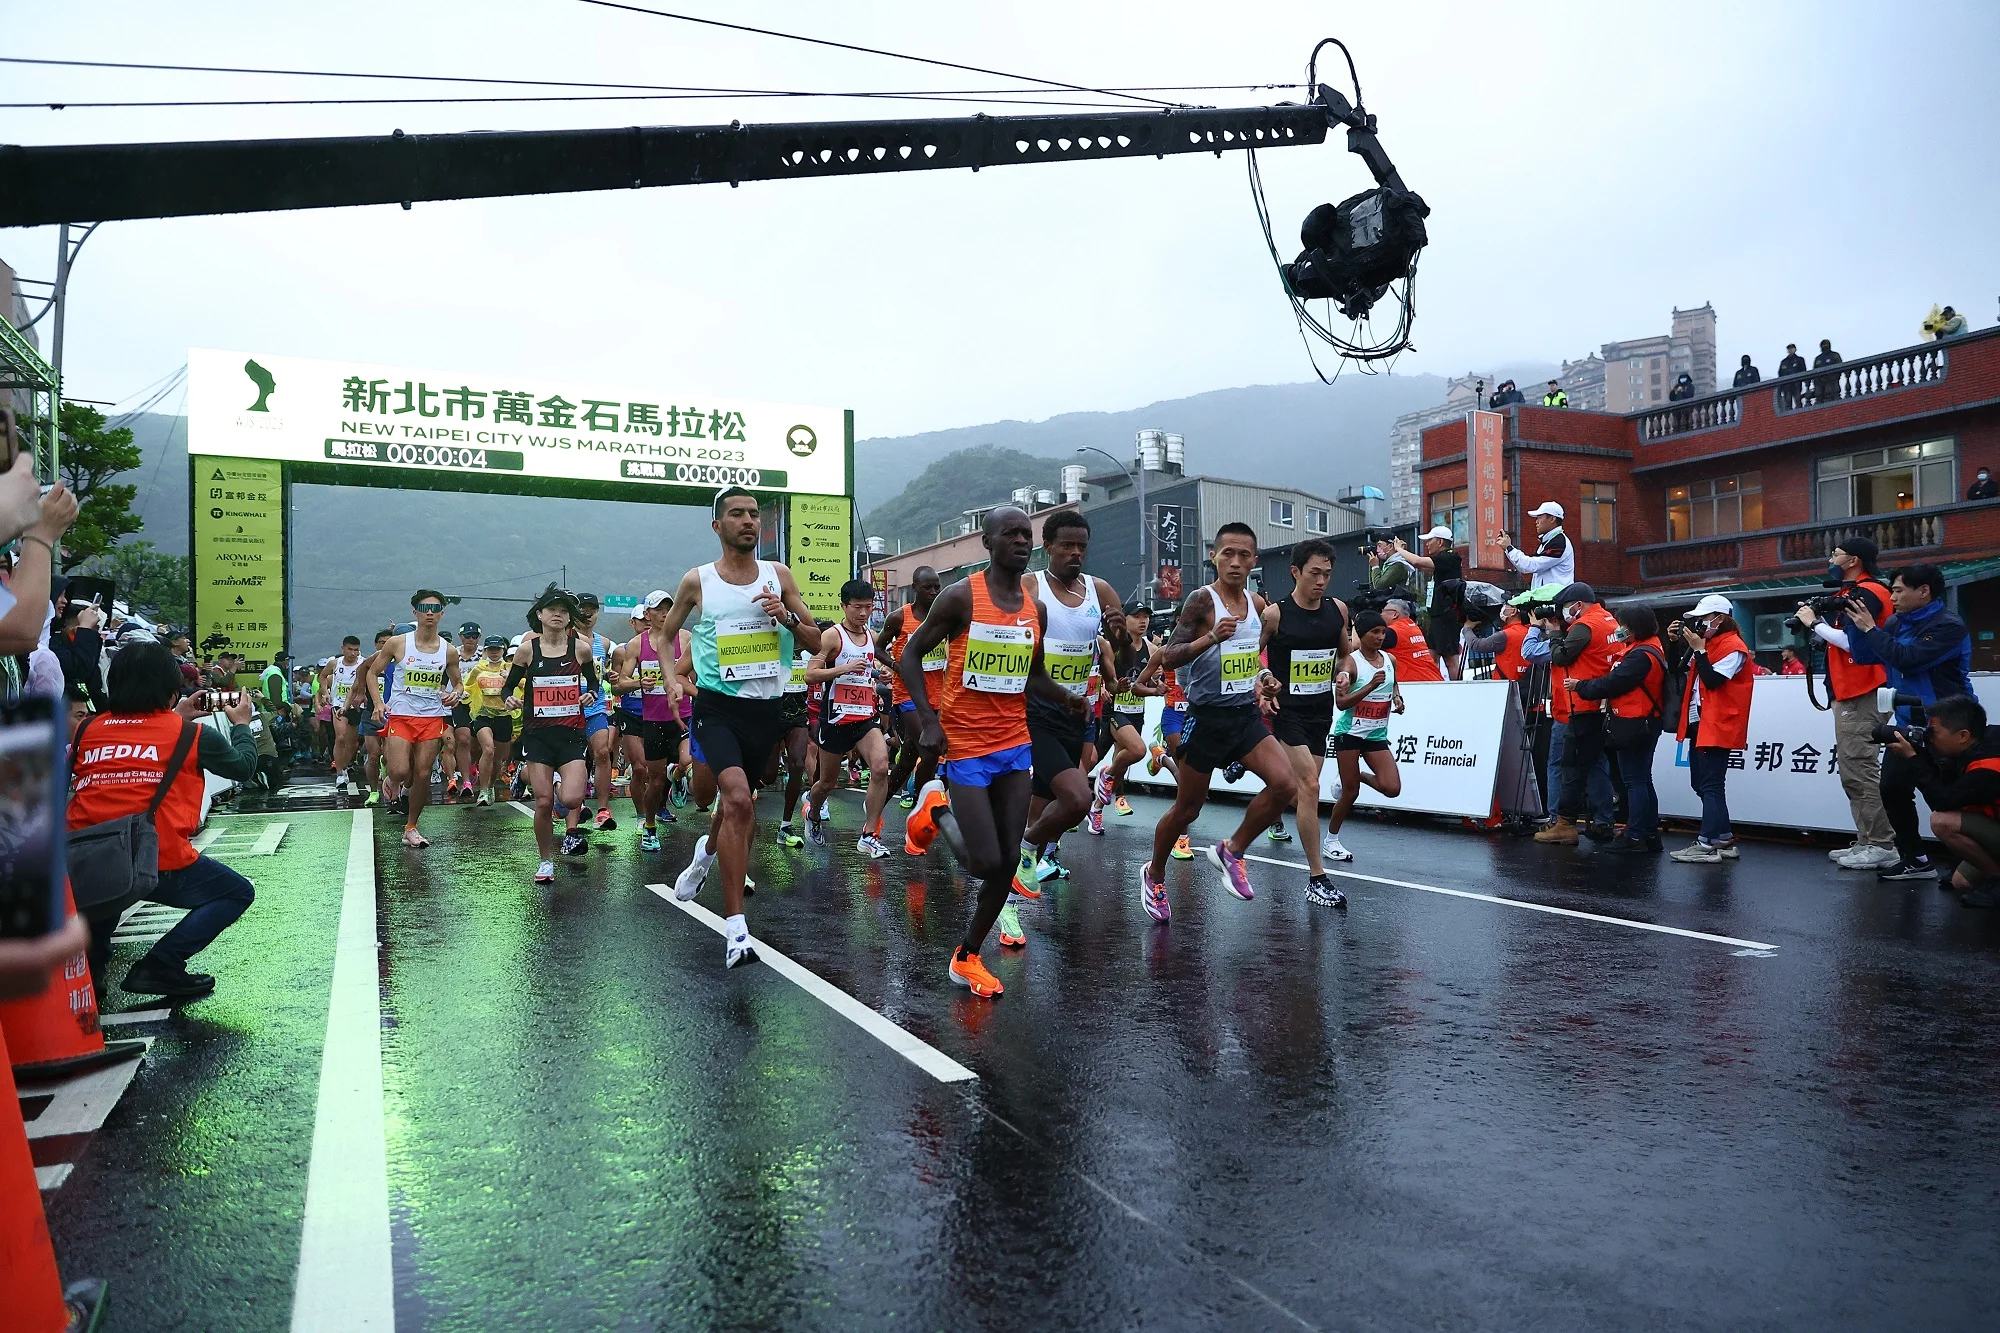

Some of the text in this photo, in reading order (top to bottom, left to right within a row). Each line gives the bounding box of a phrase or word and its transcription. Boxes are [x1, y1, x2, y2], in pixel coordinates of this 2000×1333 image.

[342, 375, 747, 443] 新北市萬金石馬拉松
[341, 421, 745, 462] NEW TAIPEI CITY WJS MARATHON 2023
[330, 441, 378, 459] 馬拉松
[386, 443, 488, 469] 00:00:04
[675, 462, 761, 487] 00:00:00
[225, 491, 267, 502] 富邦金控
[212, 575, 263, 586] aminoMax
[225, 622, 268, 632] 科正國際
[228, 641, 269, 649] STYLISH
[720, 644, 752, 656] MERZOUGUI
[967, 650, 1030, 674] KIPTUM
[725, 667, 736, 679] A
[1293, 661, 1332, 677] 11488
[406, 671, 442, 684] 10946
[966, 674, 978, 688] A
[1225, 681, 1234, 693] A
[1292, 683, 1301, 693] A
[536, 689, 576, 702] TUNG
[842, 688, 867, 701] TSAI
[537, 707, 545, 716] A
[1426, 735, 1463, 750] Fubon
[82, 744, 159, 765] MEDIA
[1423, 751, 1477, 768] Financial
